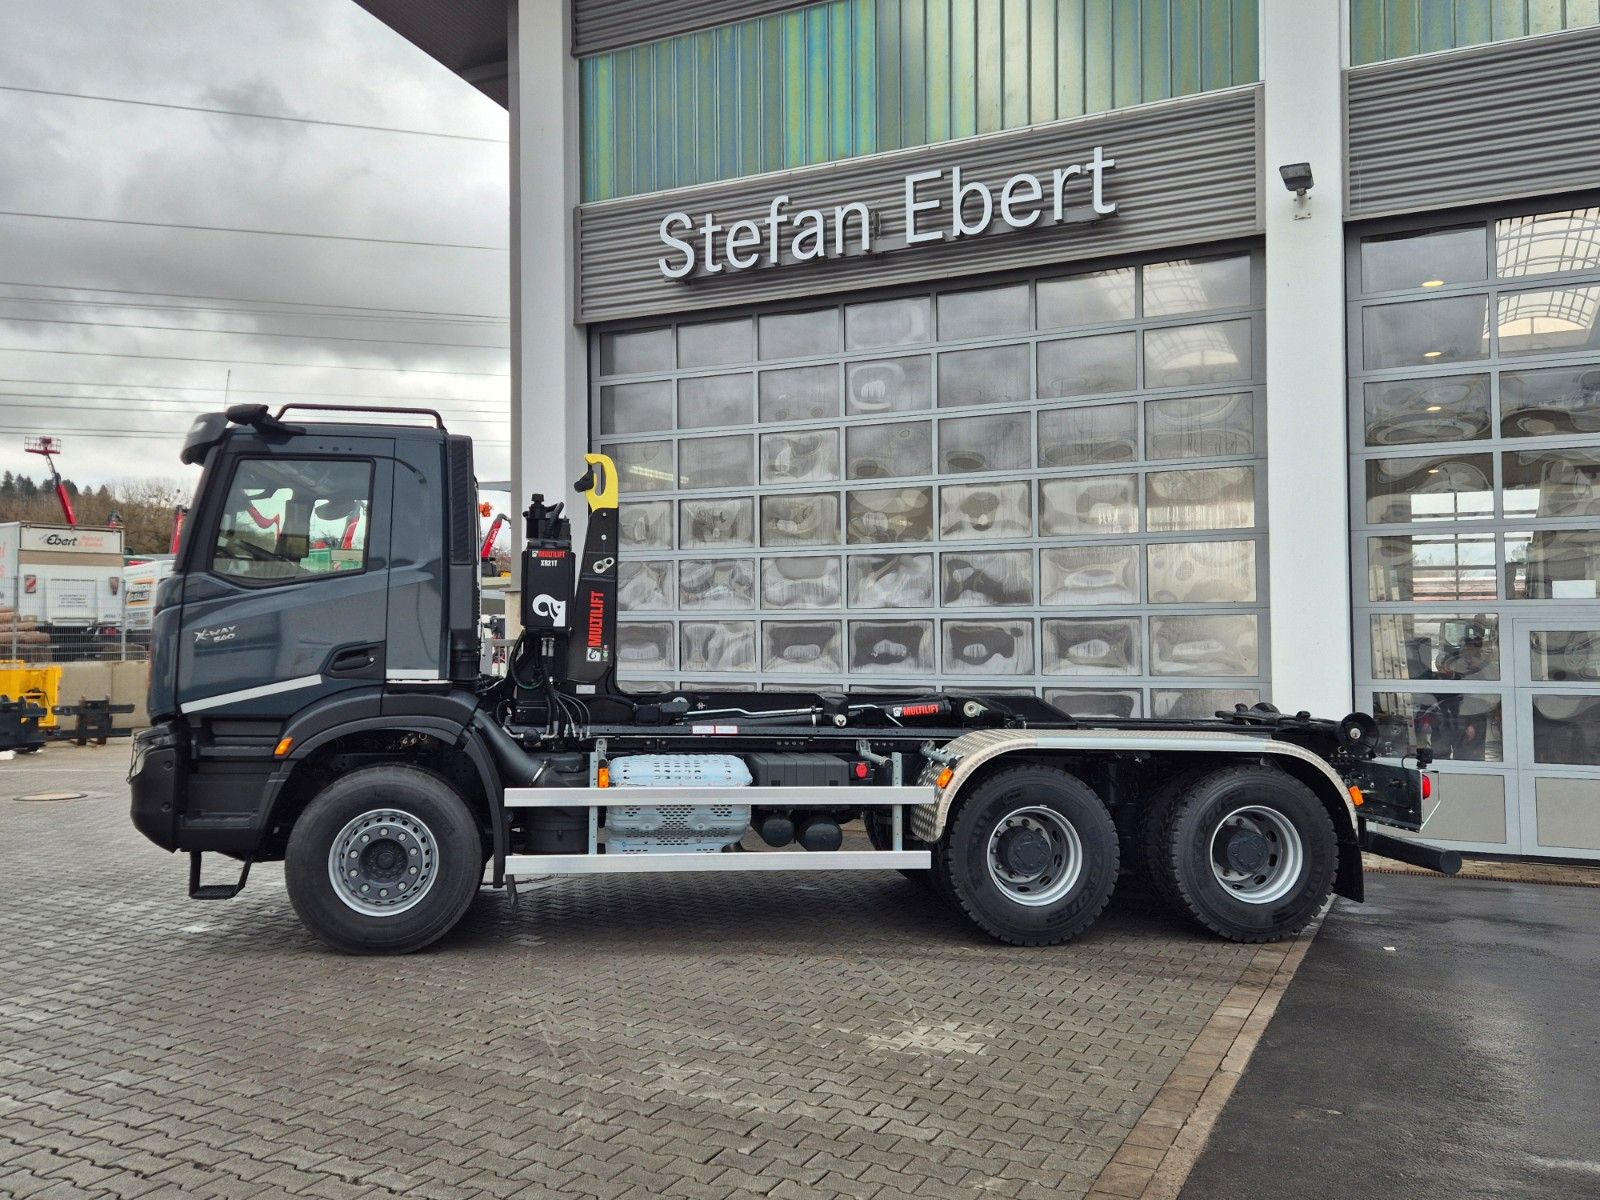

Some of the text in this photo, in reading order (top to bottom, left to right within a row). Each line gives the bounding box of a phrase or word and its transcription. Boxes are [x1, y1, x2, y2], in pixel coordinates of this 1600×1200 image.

[658, 146, 1117, 279] Stefan Ebert
[46, 534, 78, 546] Ebert
[538, 550, 566, 558] MULTILIFT
[588, 591, 604, 647] MULTILIFT
[193, 625, 236, 643] X-WAY
[902, 703, 939, 716] MULTILIFT
